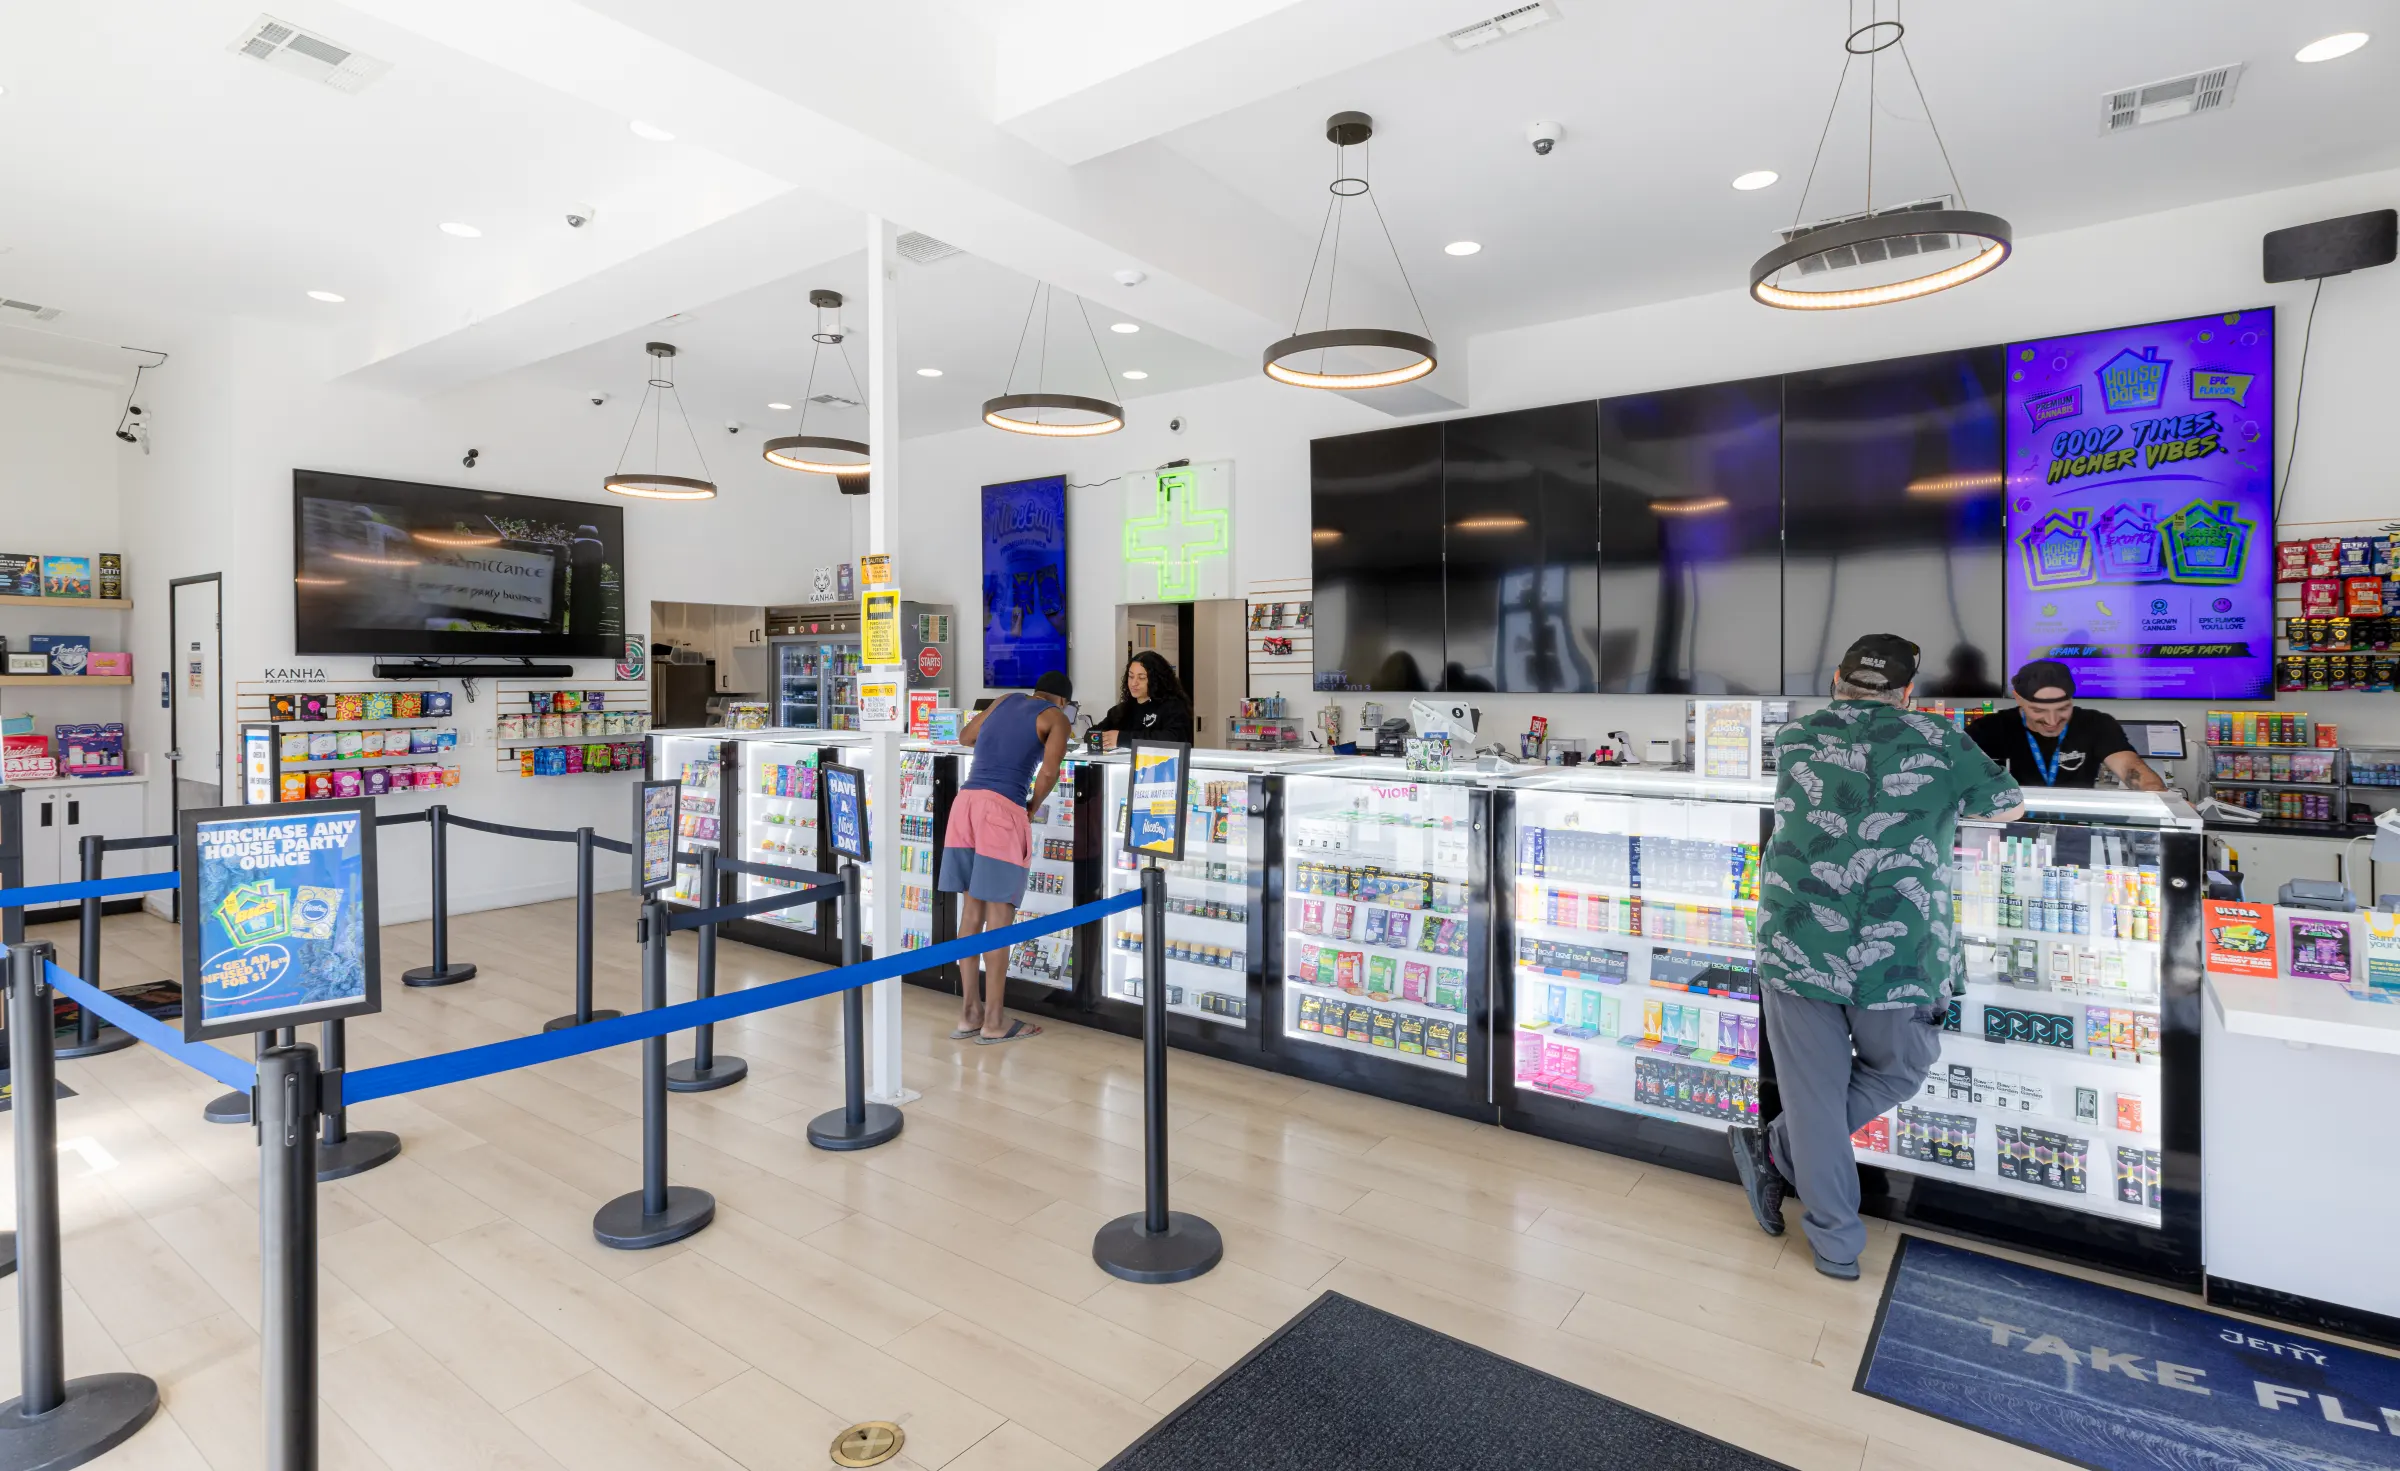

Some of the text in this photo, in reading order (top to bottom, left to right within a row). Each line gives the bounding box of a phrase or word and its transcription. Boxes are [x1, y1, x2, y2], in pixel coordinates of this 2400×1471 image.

[2208, 376, 2228, 385] EPIC
[2199, 386, 2236, 396] FLAVORS
[2035, 395, 2073, 412] PREMIUM
[2036, 404, 2074, 421] CANNABIS
[2052, 425, 2123, 457] GOOD
[2047, 434, 2228, 485] HIGHER VIBES.
[992, 498, 1054, 544] NiceGuy
[100, 567, 120, 575] JETTY
[810, 593, 834, 602] KANHA
[2082, 647, 2097, 655] UP
[2159, 646, 2196, 655] HOUSE
[2197, 645, 2233, 654] PARTY
[920, 657, 941, 667] STARTS
[264, 668, 326, 679] KANHA
[4, 759, 52, 772] AKE
[830, 779, 857, 797] HAVE
[1135, 789, 1174, 799] PLEASE WAIT HERE
[651, 808, 666, 817] HOT
[841, 800, 848, 813] A
[648, 815, 668, 825] AUGUST
[838, 815, 855, 836] Nice
[197, 820, 356, 846] PURCHASE ANY
[1142, 819, 1166, 839] NiceGuy
[205, 834, 349, 860] HOUSE PARTY
[838, 835, 857, 852] DAY
[240, 851, 311, 870] OUNCE
[2214, 906, 2262, 919] ULTRA
[2369, 941, 2394, 949] your
[250, 953, 270, 965] AN
[222, 971, 267, 989] FOR $1
[1973, 1082, 1995, 1091] Garden
[1996, 1081, 2010, 1089] Raw
[1996, 1086, 2019, 1095] Garden
[2020, 1085, 2035, 1093] Raw
[2020, 1090, 2043, 1099] Garden
[2219, 1328, 2330, 1367] JETTY
[1976, 1316, 2212, 1396] TAKE
